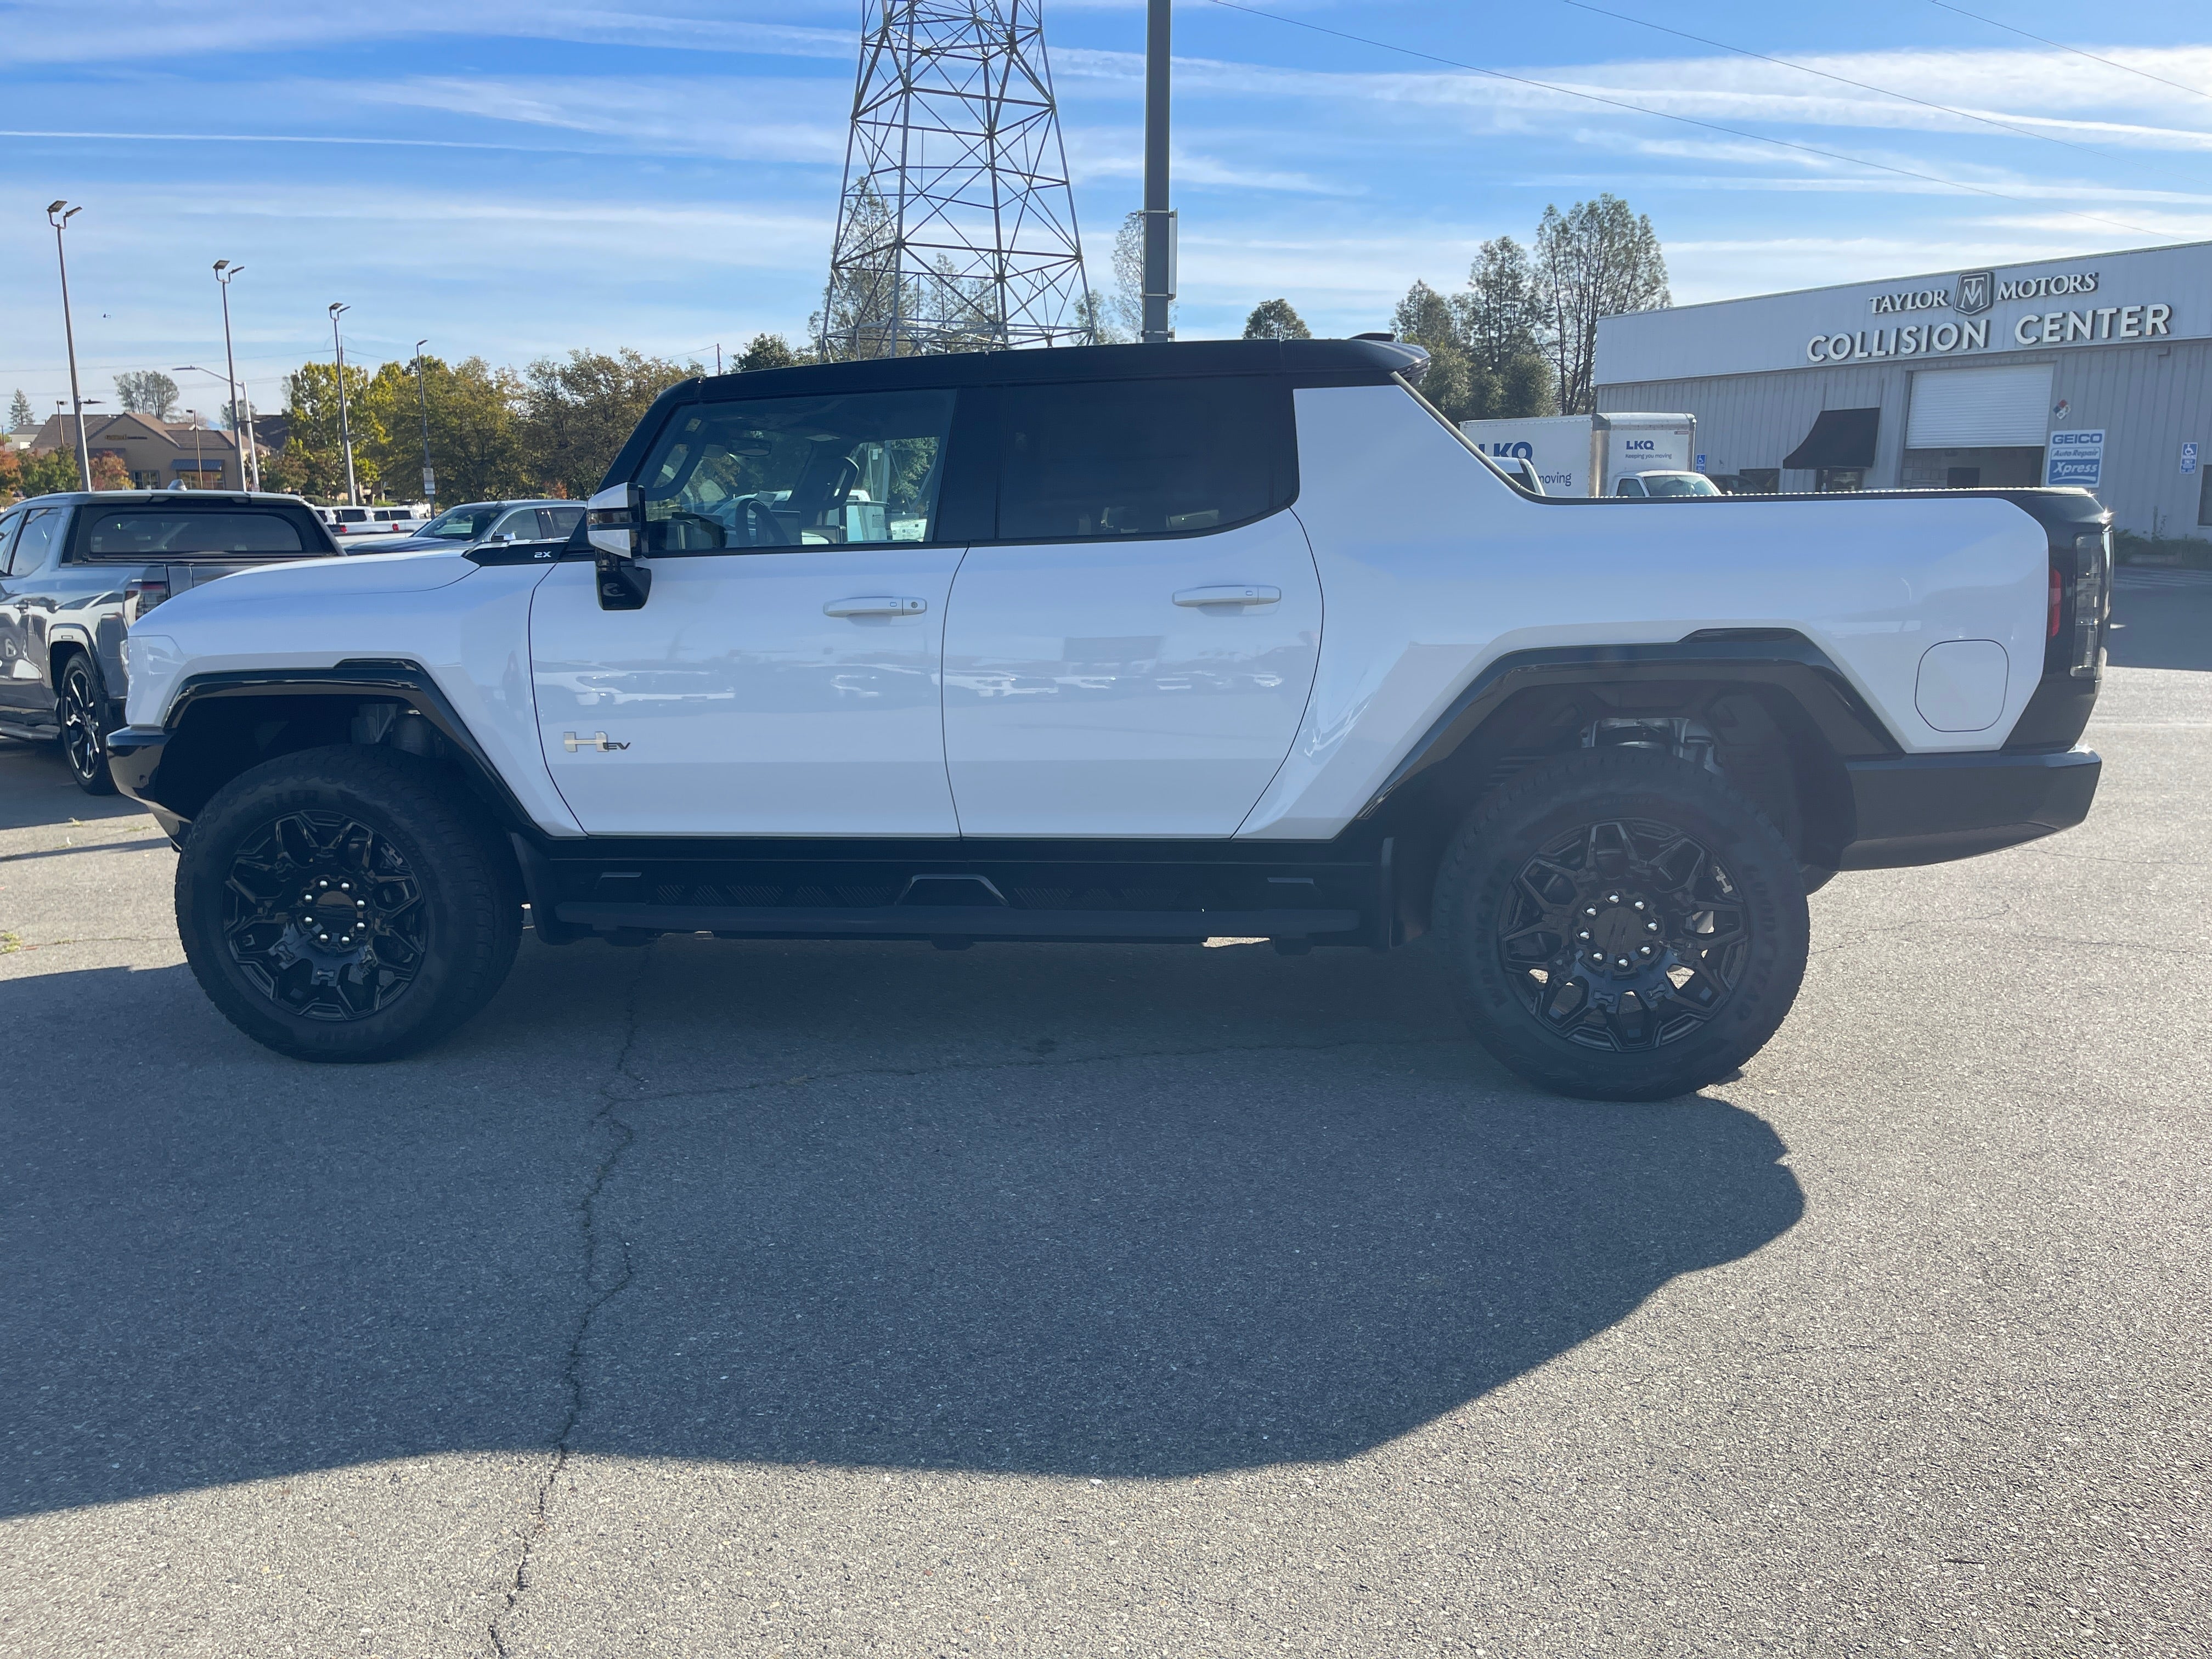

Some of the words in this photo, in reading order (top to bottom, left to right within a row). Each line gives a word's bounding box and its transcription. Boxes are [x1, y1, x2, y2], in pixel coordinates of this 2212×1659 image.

[1869, 289, 1950, 314] TAYLOR
[1996, 272, 2099, 301] MOTORS
[1806, 319, 1990, 363] COLLISION
[2014, 303, 2172, 345] CENTER
[1626, 440, 1655, 450] LKQ
[2052, 433, 2103, 445] GEICO
[2072, 449, 2099, 459] Repair
[2053, 461, 2098, 476] Xpress
